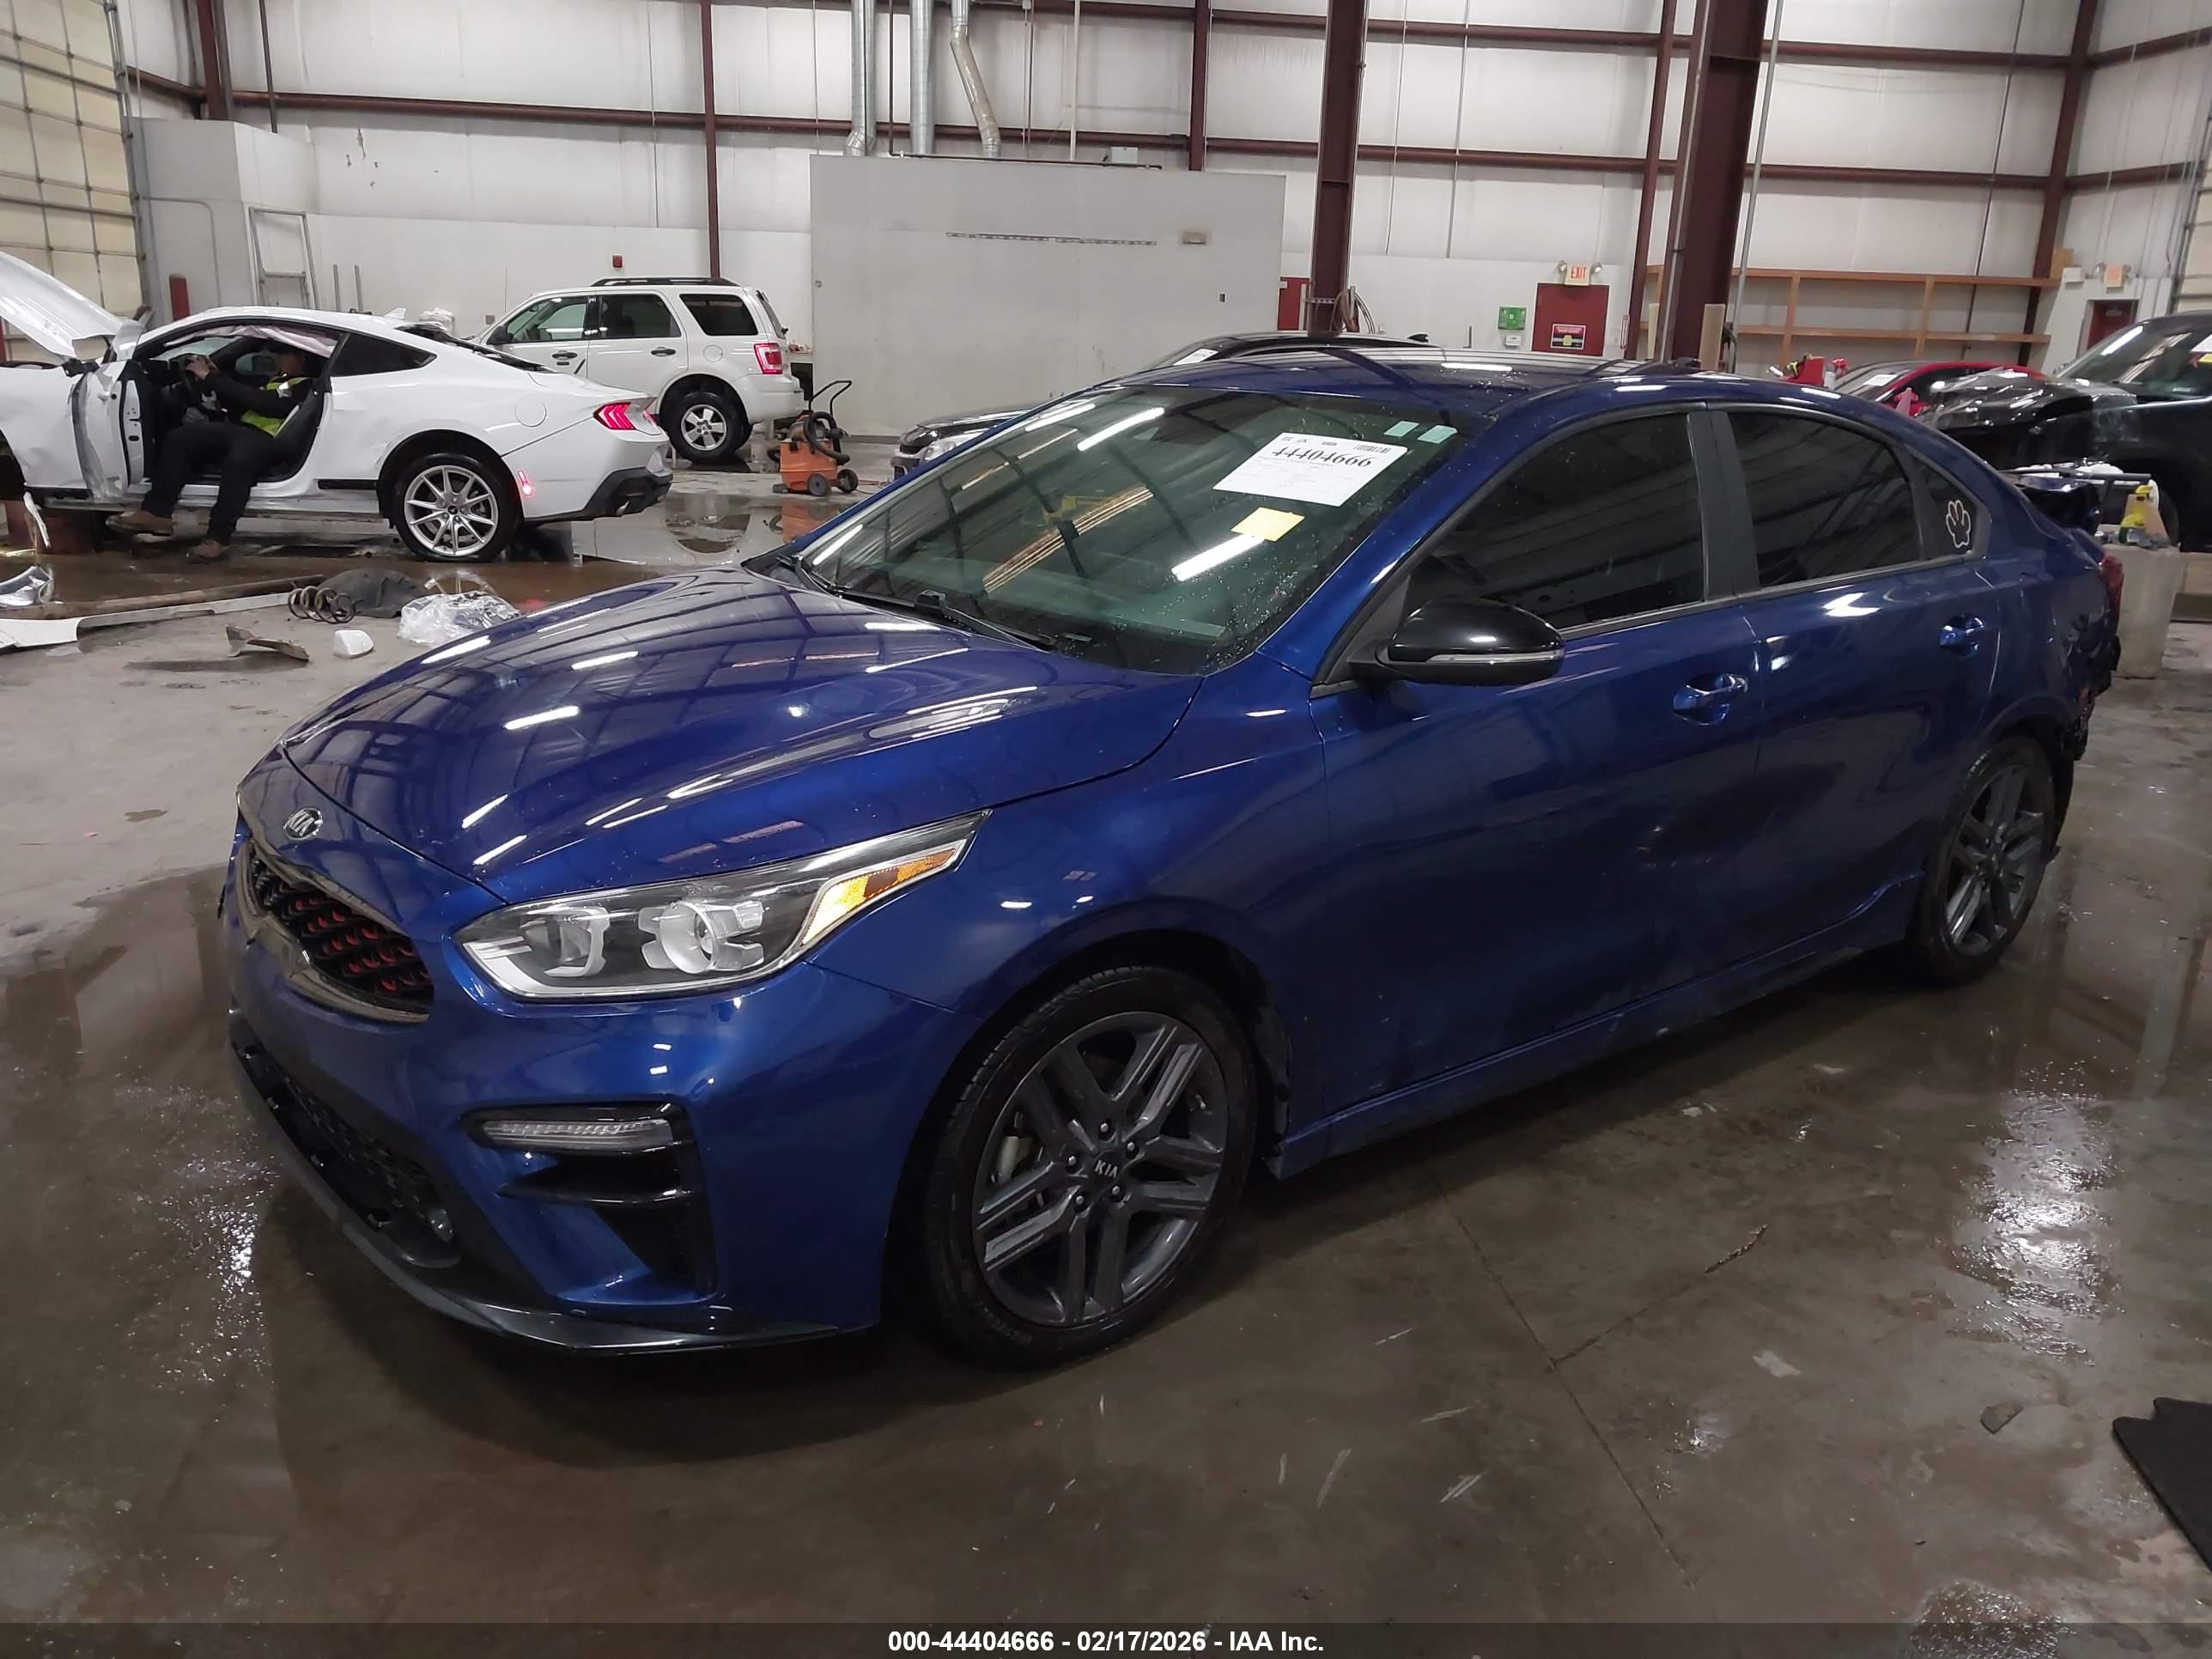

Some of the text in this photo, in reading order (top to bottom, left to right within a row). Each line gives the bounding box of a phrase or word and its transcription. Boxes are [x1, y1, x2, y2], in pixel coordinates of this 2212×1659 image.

[1571, 266, 1587, 279] EXIT
[1272, 447, 1376, 468] 44404666
[287, 810, 315, 837] KIA
[1094, 1159, 1118, 1178] KIA
